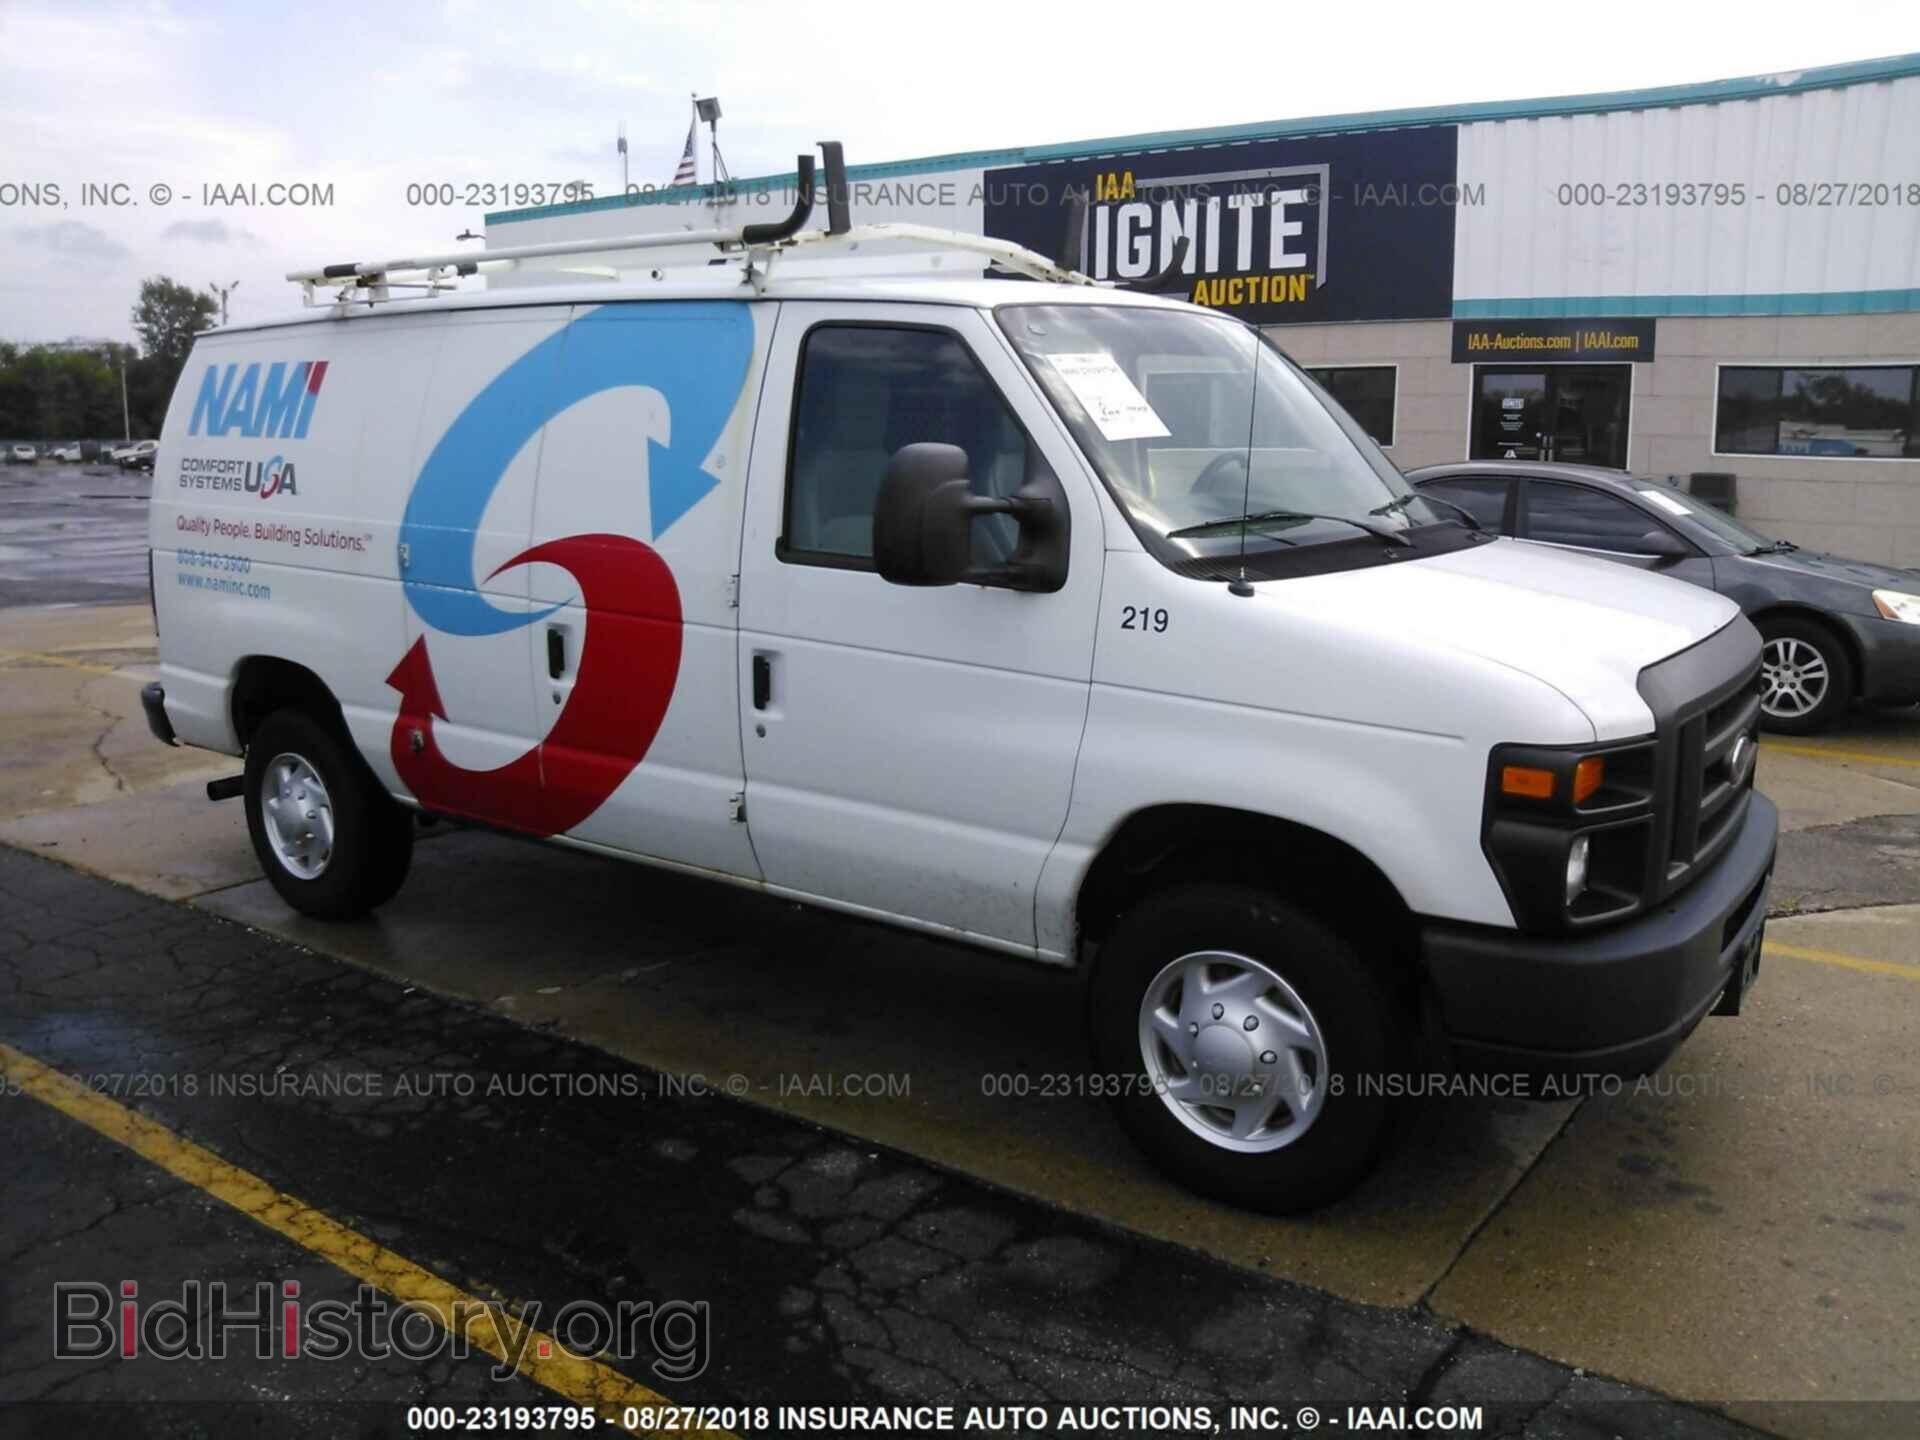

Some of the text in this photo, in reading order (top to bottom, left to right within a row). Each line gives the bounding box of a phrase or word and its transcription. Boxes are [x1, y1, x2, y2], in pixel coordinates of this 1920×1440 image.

[1096, 171, 1136, 200] IAA
[1095, 189, 1308, 280] IGNITE
[1193, 274, 1308, 306] AUCTION
[1468, 331, 1639, 350] IAA-Auctions.com IAAI.com
[187, 361, 330, 439] NAMI
[181, 457, 244, 478] COMFORT
[244, 455, 297, 499] USA
[179, 473, 242, 493] SYSTEMS
[176, 514, 211, 537] Quality
[254, 522, 301, 548] Building
[1121, 606, 1169, 633] 219
